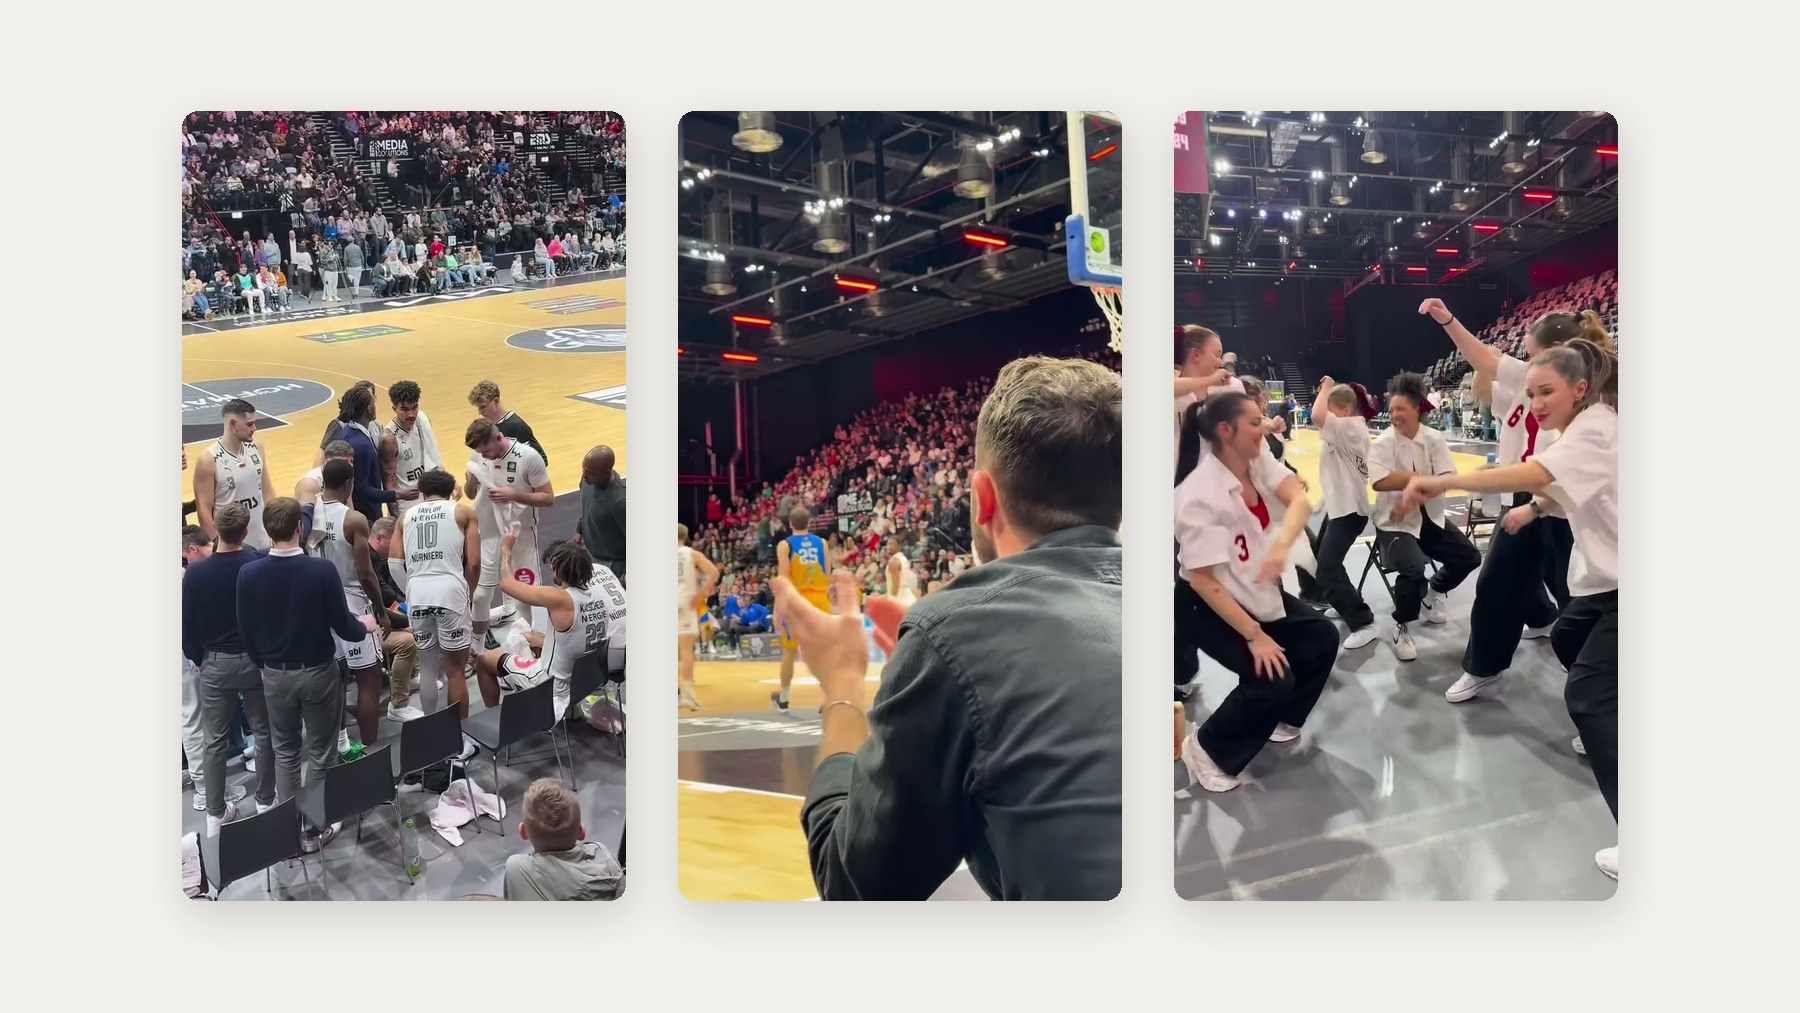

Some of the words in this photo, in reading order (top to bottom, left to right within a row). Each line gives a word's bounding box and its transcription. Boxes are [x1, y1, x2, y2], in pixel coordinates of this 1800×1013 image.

[377, 139, 408, 150] MEDIA
[1507, 403, 1524, 428] 6
[416, 521, 438, 550] 10
[1234, 534, 1249, 562] 3
[603, 582, 626, 607] 5
